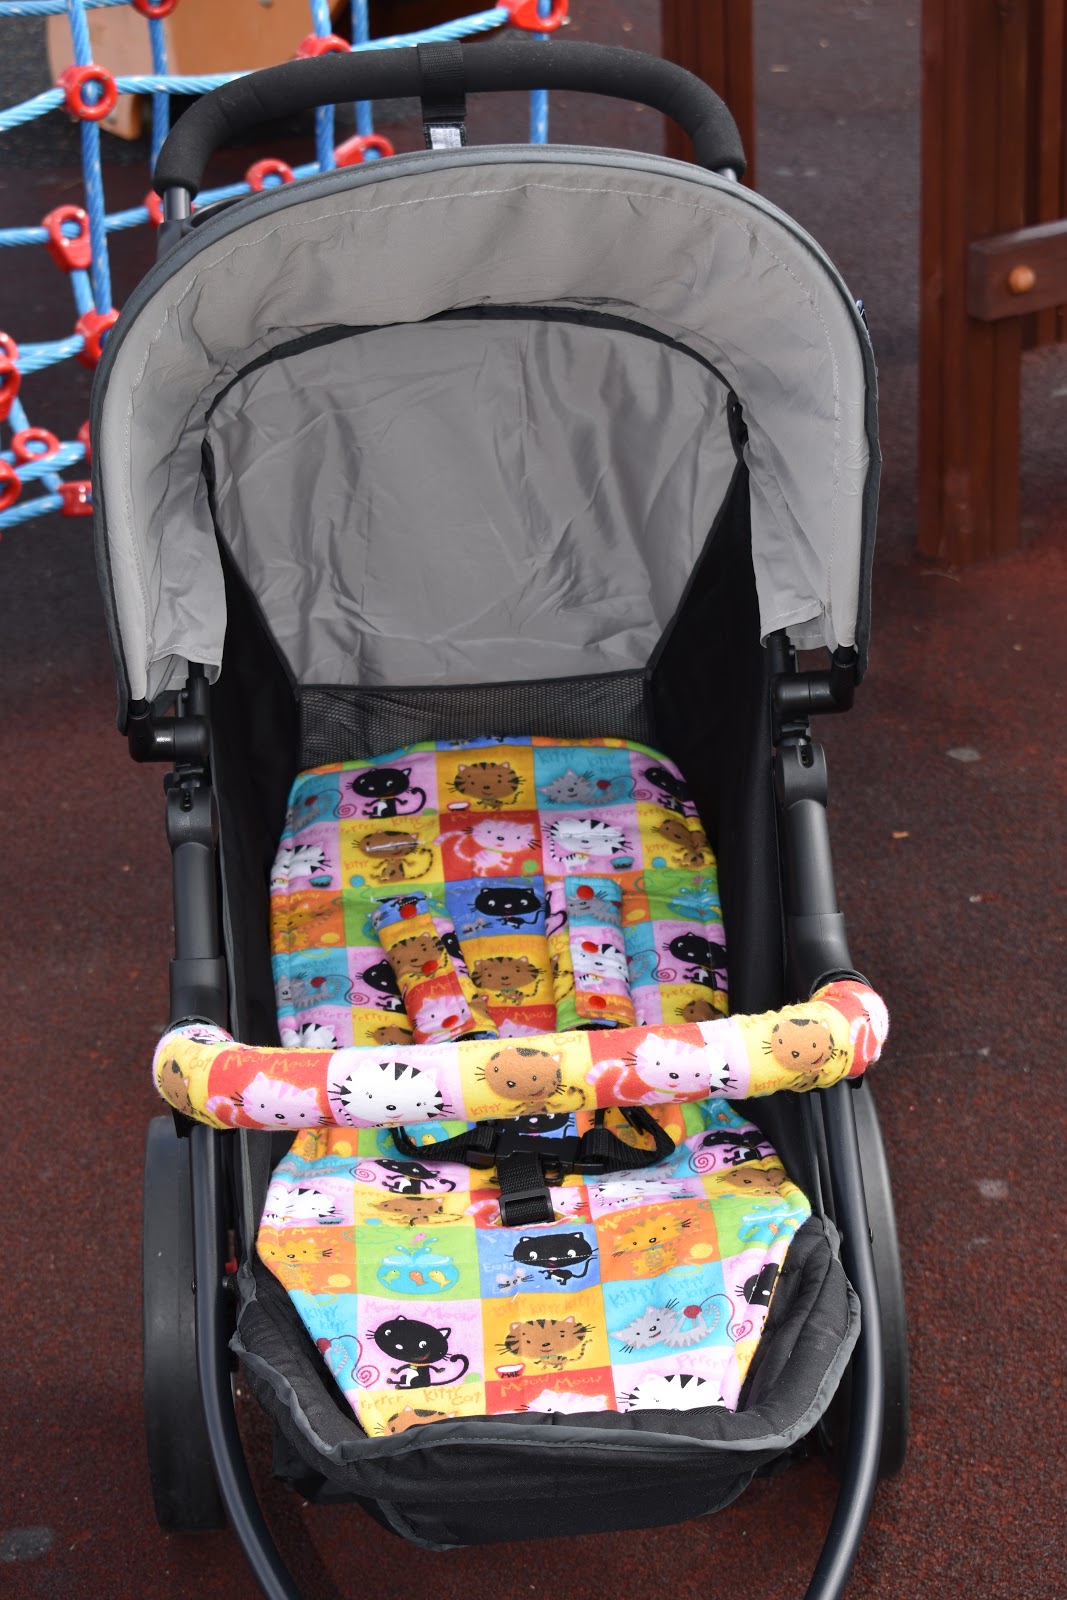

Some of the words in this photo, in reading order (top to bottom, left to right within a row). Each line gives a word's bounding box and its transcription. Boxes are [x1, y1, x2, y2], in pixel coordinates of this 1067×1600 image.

[269, 1057, 320, 1076] Meow
[500, 1375, 550, 1398] Meow
[553, 1375, 603, 1392] Meow
